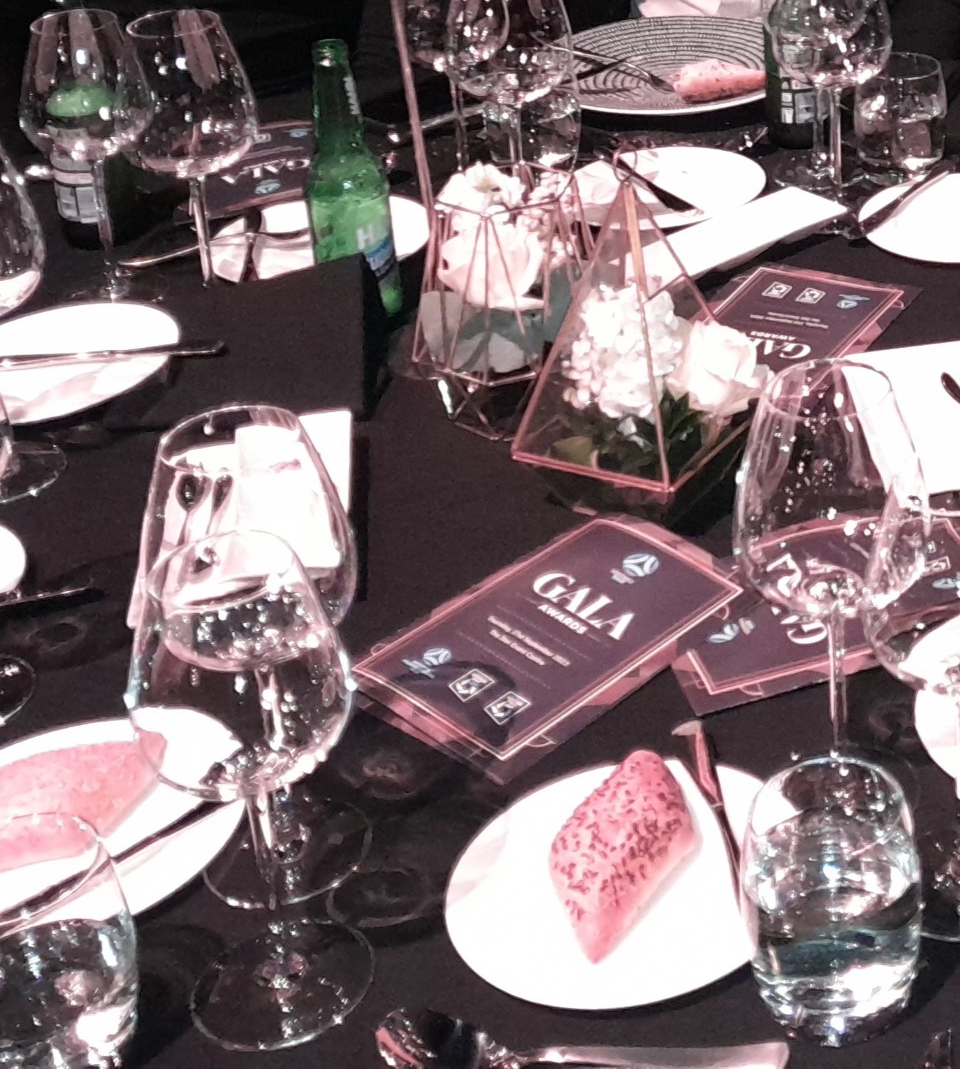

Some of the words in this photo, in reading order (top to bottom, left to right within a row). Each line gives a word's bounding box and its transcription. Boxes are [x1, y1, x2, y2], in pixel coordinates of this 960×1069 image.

[750, 338, 811, 359] GA
[532, 572, 636, 641] GALA
[537, 604, 588, 635] AWARDS
